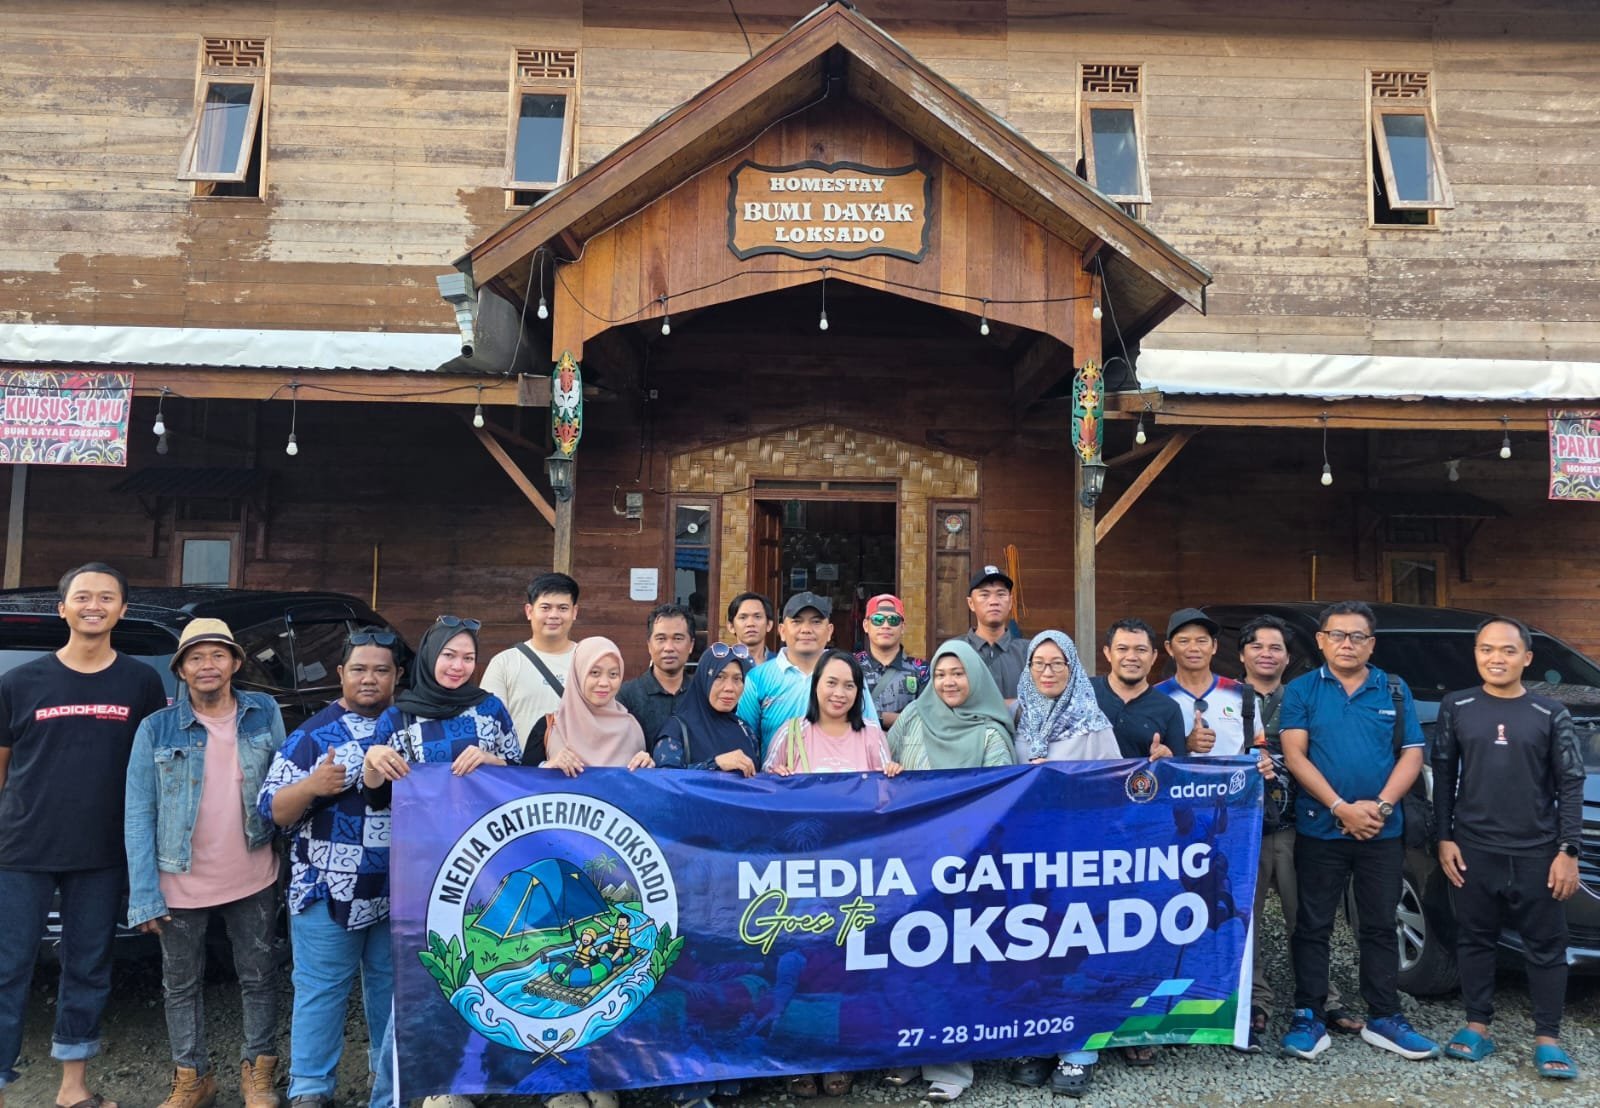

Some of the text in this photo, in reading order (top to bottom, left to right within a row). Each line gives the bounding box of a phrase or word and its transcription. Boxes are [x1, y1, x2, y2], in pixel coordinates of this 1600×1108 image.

[770, 178, 885, 192] HOMESTAY
[744, 202, 914, 222] BUMI DAYAK
[775, 227, 885, 242] LOKSADO
[5, 396, 123, 422] KHUSUS TAMU
[4, 427, 111, 438] BUMI DAYAK LOKSADO
[35, 704, 130, 721] RADIOHEAD
[1170, 782, 1228, 799] adaro
[439, 802, 669, 905] MEDIA GATHERING LOKSADO
[738, 843, 1211, 899] MEDIA GATHERING
[738, 889, 876, 954] Goes to
[845, 892, 1209, 971] LOKSADO
[898, 1029, 924, 1047] 27
[942, 1026, 968, 1044] 28
[973, 1020, 1018, 1041] Juni
[1023, 1016, 1074, 1037] 2026
